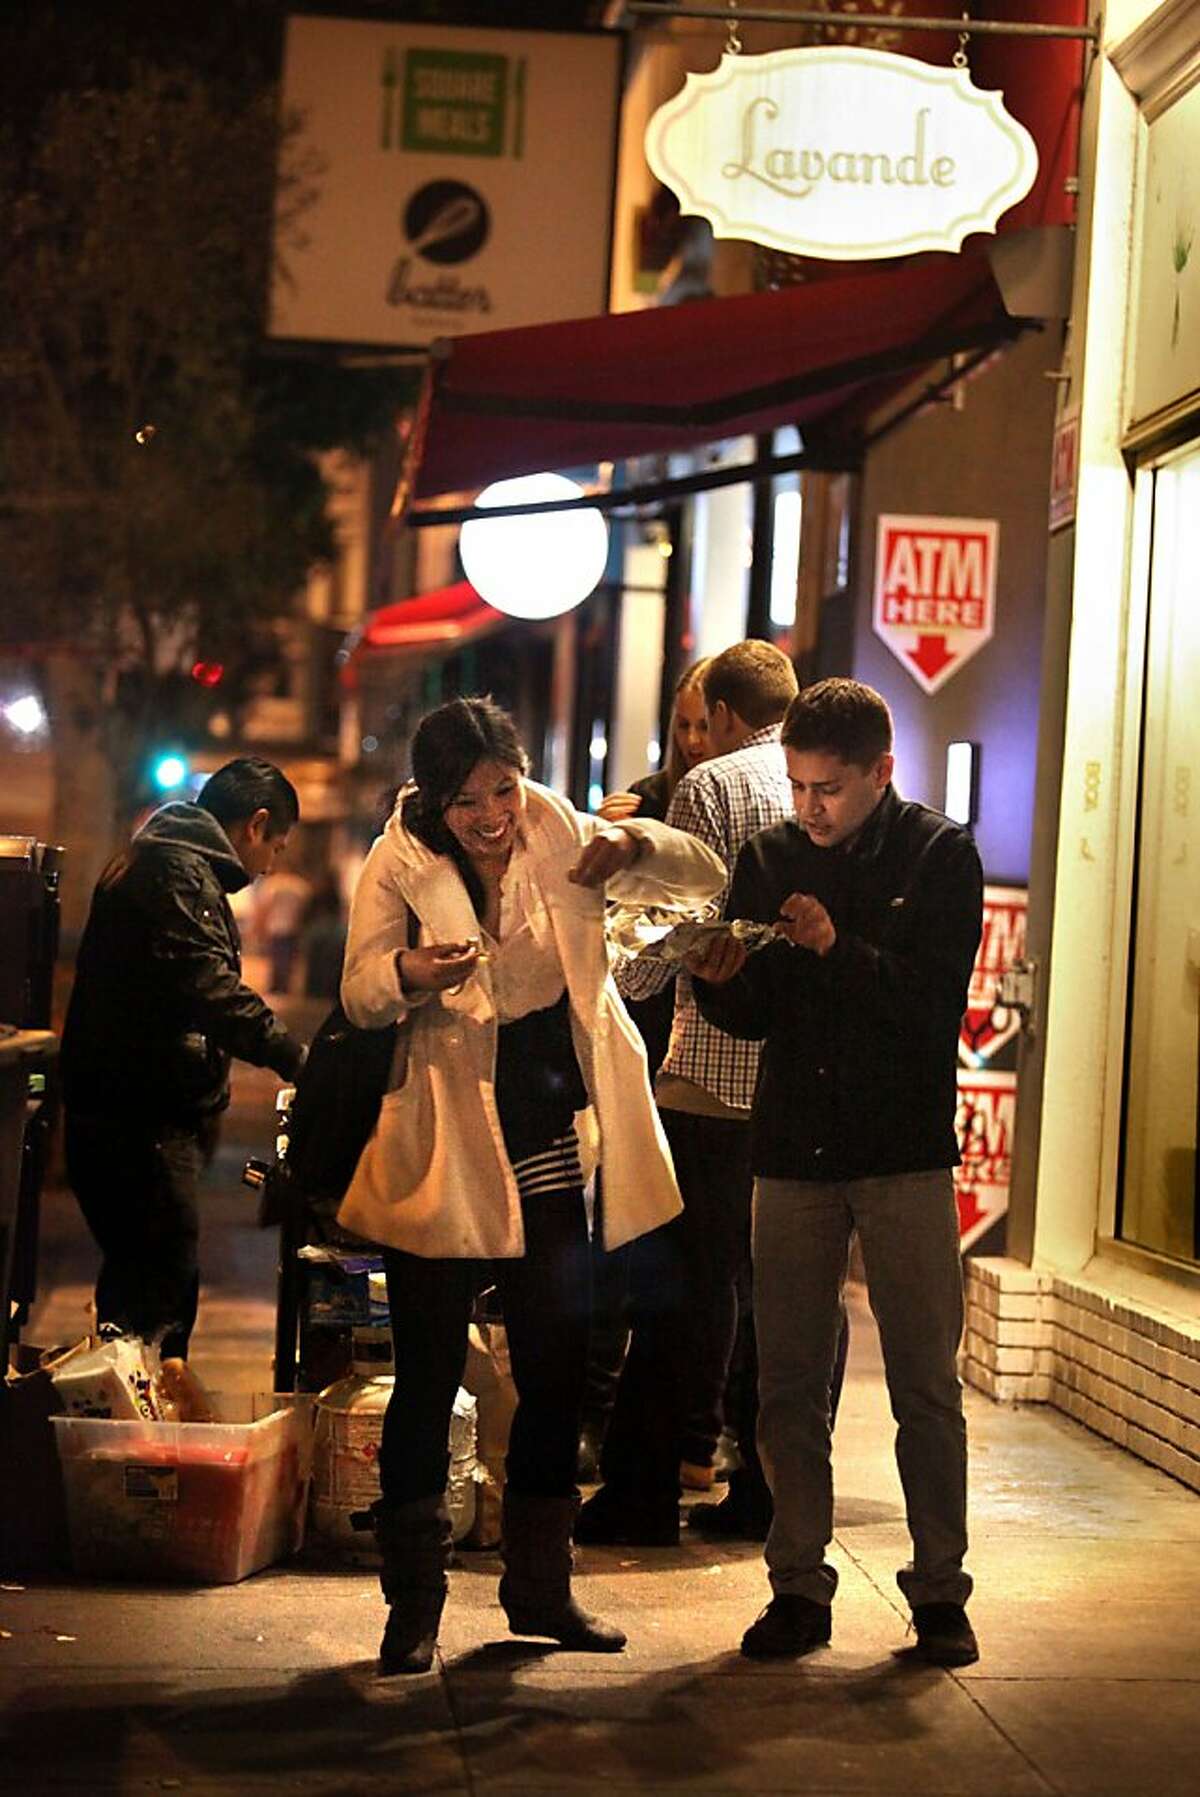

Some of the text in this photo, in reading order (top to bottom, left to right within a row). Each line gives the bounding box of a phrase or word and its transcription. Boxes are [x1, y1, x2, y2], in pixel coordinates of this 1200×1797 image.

[413, 67, 496, 103] SQUARE
[417, 106, 490, 142] MEALS
[721, 97, 956, 198] Lavande
[885, 536, 982, 600] ATM
[886, 599, 979, 625] HERE
